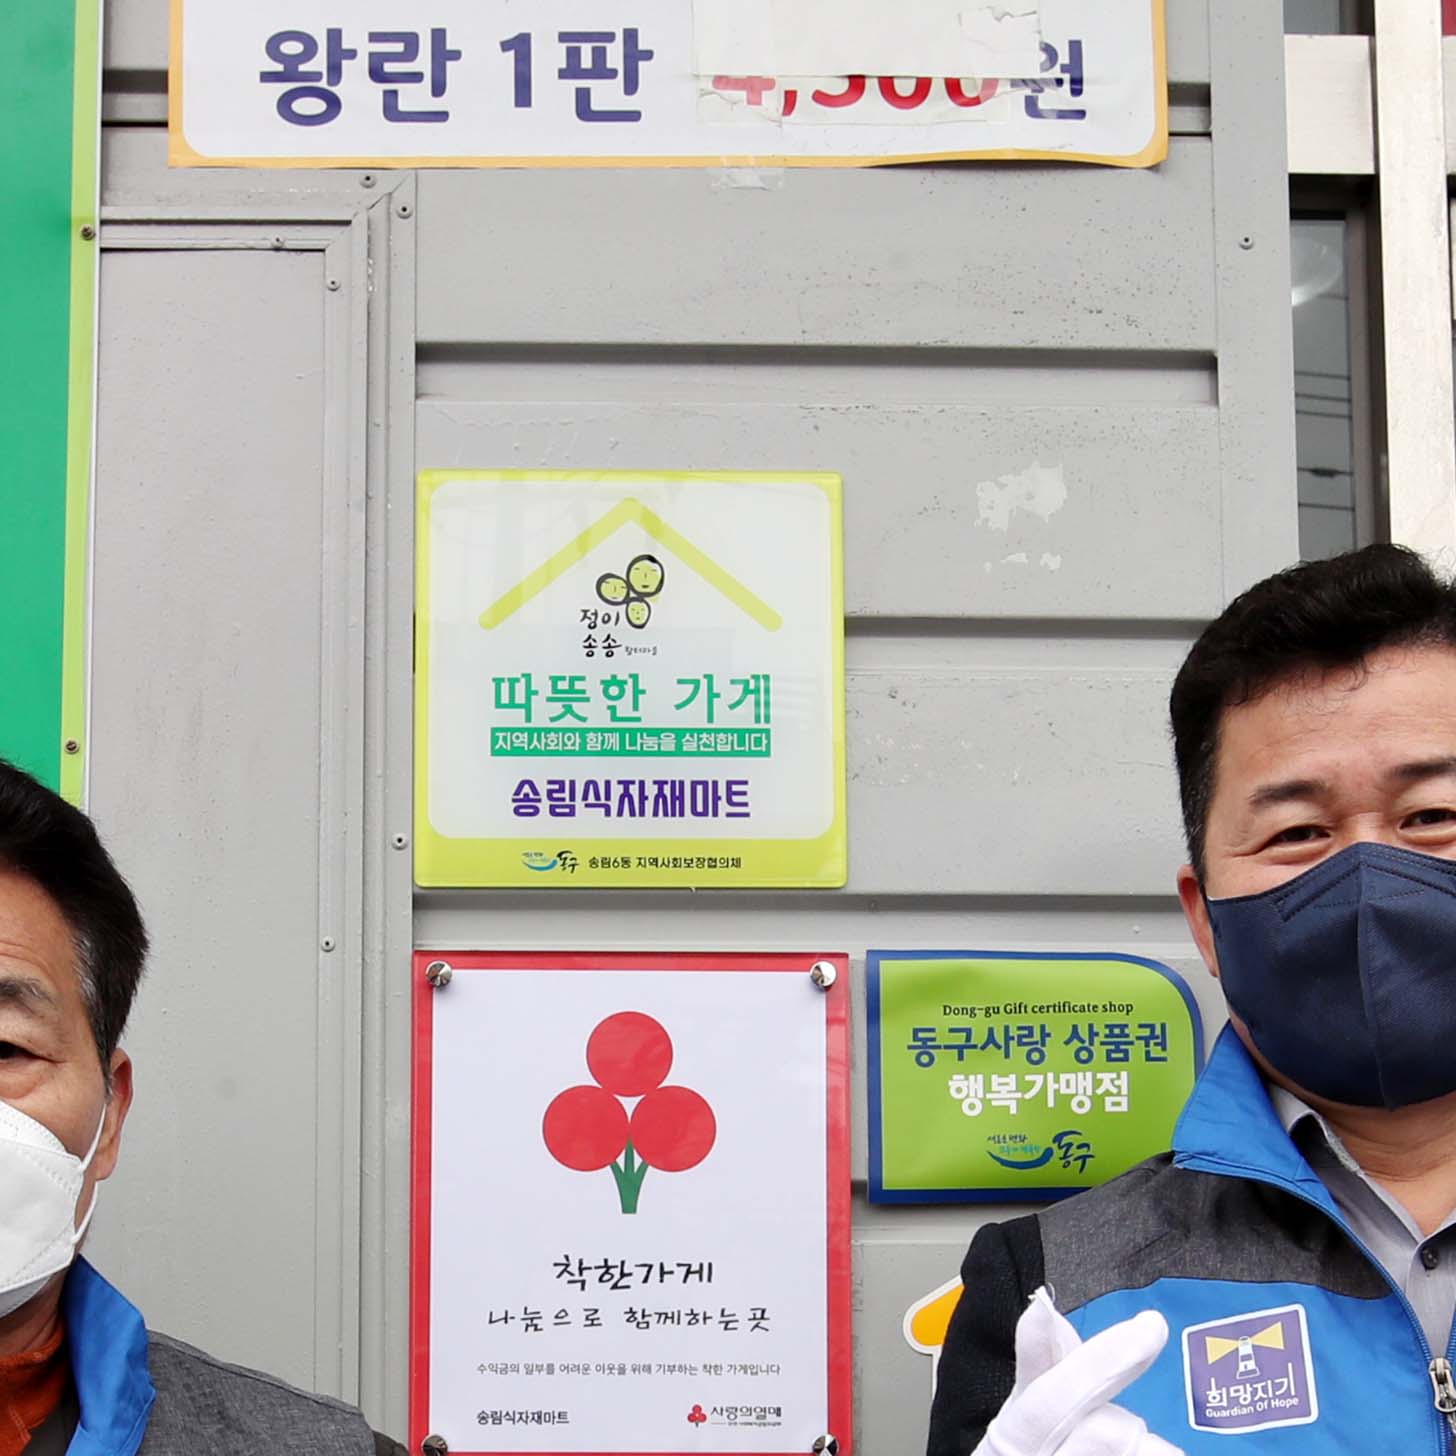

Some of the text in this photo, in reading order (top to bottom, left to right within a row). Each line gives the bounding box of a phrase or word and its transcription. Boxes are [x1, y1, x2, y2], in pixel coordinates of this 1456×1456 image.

[259, 28, 462, 126] 왕란
[499, 33, 532, 108] 1
[556, 28, 654, 122] 판
[580, 608, 620, 630] 정이
[582, 633, 622, 658] 송송
[491, 673, 771, 724] 따뜻한 가게
[495, 731, 768, 752] 지역사회와 함께 나눔을 실천합니다
[512, 778, 751, 818] 송림식자재마트
[588, 857, 631, 869] 송림6동
[636, 856, 741, 870] 지역사회보장협의체
[943, 1001, 1134, 1019] Dong-gu Gift certificate shop
[907, 1022, 1168, 1068] 동구사랑 상품권
[948, 1071, 1129, 1117] 행복가맹점
[553, 1254, 714, 1292] 착한가게
[488, 1306, 603, 1333] 나눔으로
[477, 1363, 781, 1376] 수익금의 일부를 어려운 이웃을 위해 기부하는 착한 가게입니다
[1206, 1361, 1296, 1408] 희망지기
[476, 1409, 570, 1426] 송림식자재마트
[1205, 1404, 1255, 1418] Guardian
[1271, 1397, 1299, 1409] Hope
